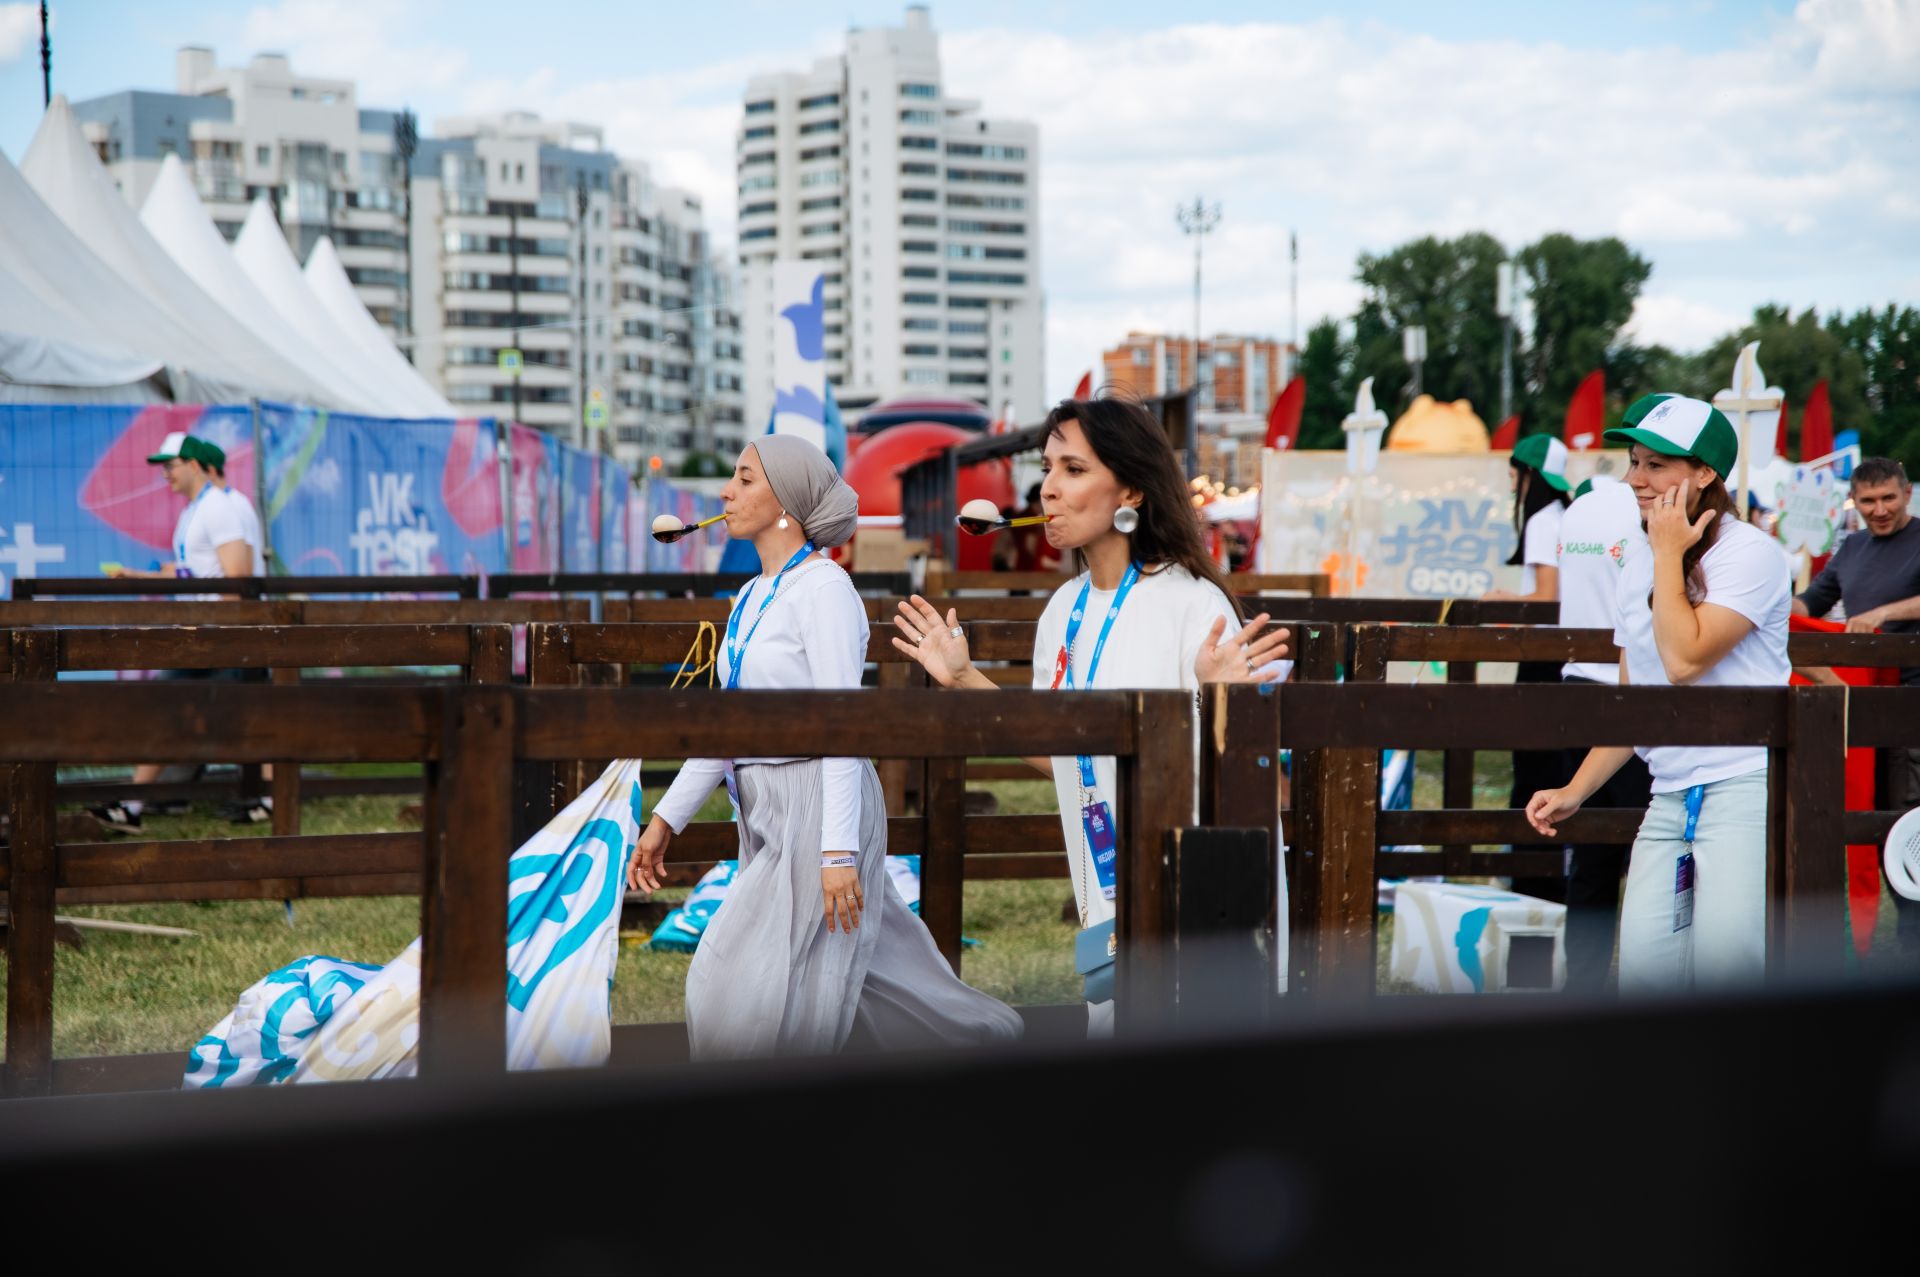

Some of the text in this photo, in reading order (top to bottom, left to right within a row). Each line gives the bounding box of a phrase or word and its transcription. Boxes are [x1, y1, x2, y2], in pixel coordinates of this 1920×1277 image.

[369, 472, 416, 525] VK
[350, 508, 438, 576] fest
[1566, 542, 1605, 555] КАЗАНЬ
